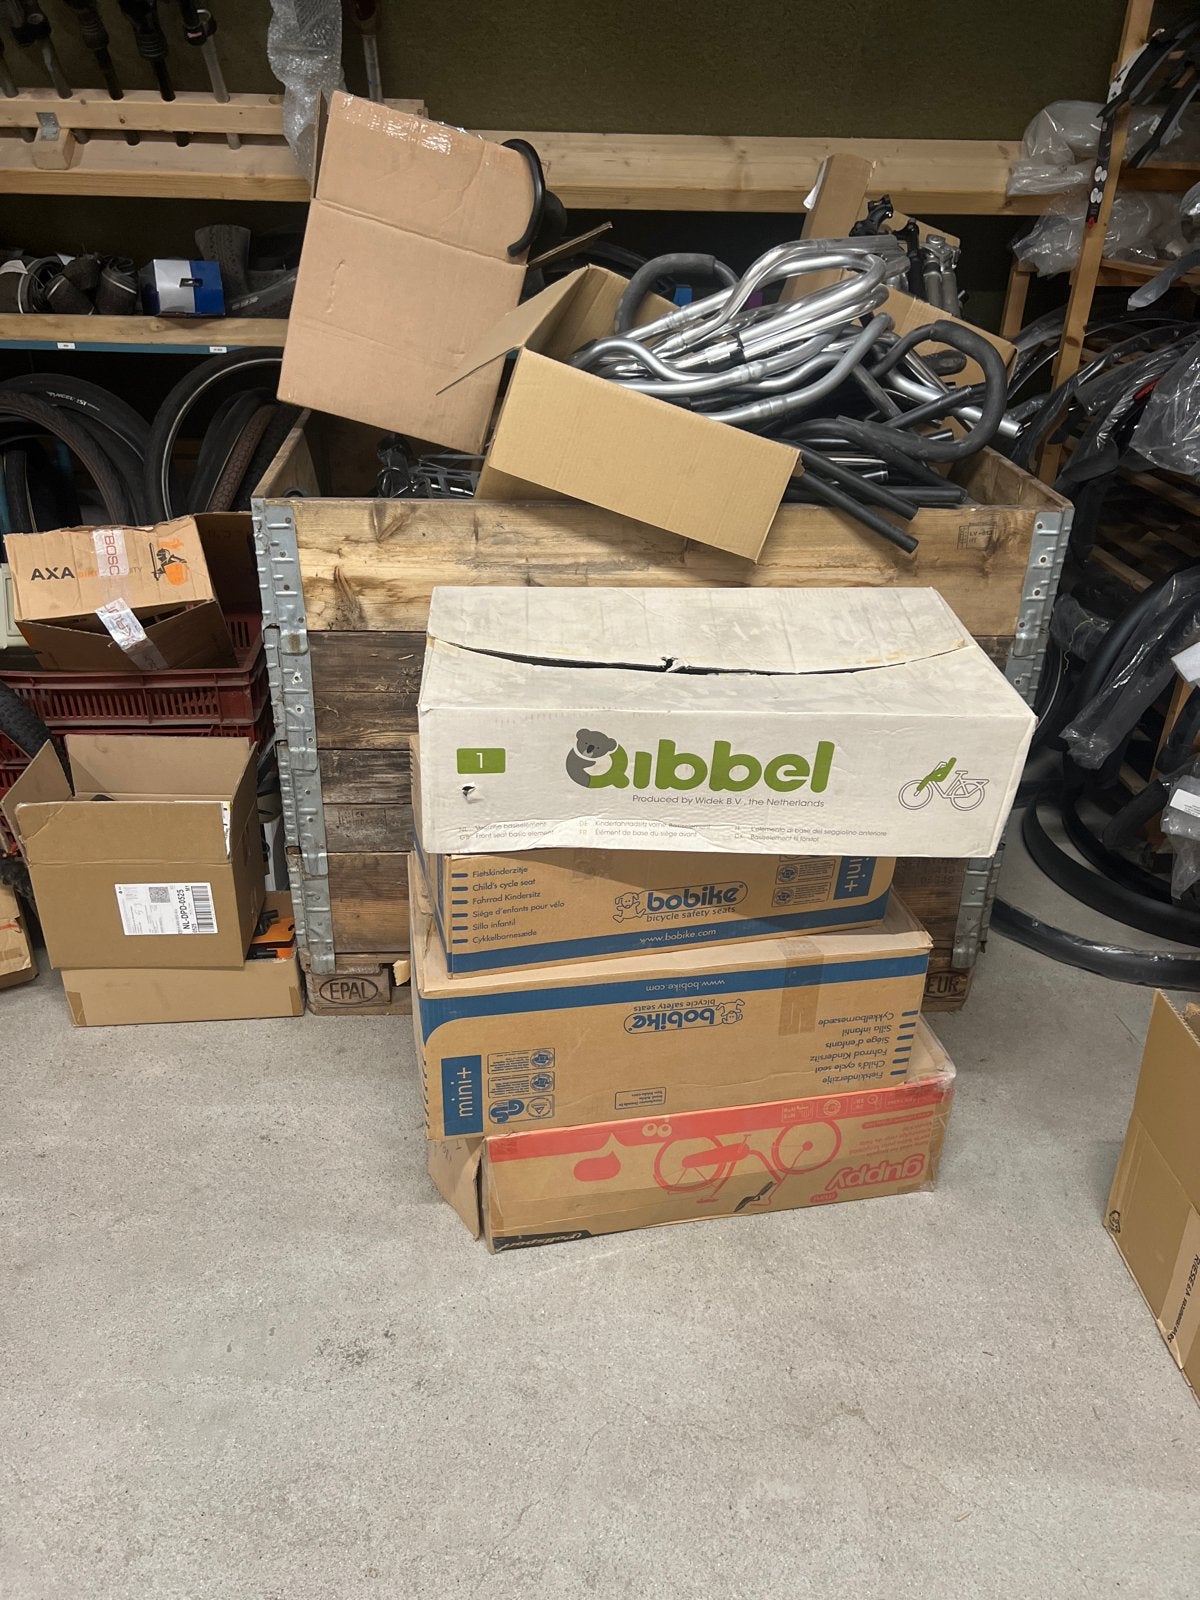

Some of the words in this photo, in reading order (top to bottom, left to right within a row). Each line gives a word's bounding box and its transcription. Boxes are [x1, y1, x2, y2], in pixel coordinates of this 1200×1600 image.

[31, 566, 76, 581] AXA
[476, 753, 484, 769] 1
[566, 737, 835, 793] Qibbel
[632, 794, 679, 804] Produced
[681, 796, 694, 806] by
[695, 796, 724, 806] Widek
[748, 798, 764, 807] the
[766, 798, 825, 808] Netherlands
[472, 867, 529, 879] Fietskinderzitje
[472, 882, 498, 892] Child's
[499, 879, 519, 890] cycle
[520, 878, 536, 887] seat
[472, 893, 503, 905] Fahrrad
[505, 891, 541, 901] Kindersitz
[647, 884, 740, 912] bobike
[177, 889, 190, 930] NL-DPD-0525
[530, 904, 549, 912] pour
[550, 900, 565, 908] vélo
[646, 912, 680, 923] bicycle
[682, 908, 710, 919] safety
[712, 905, 736, 915] seats
[472, 922, 489, 931] Silla
[491, 918, 516, 929] infantil
[639, 928, 717, 945] www.bobike.com
[330, 981, 371, 994] EPAL
[645, 979, 726, 993] www.bobike.com
[926, 975, 960, 994] EUR
[633, 1004, 656, 1012] seats
[657, 1002, 685, 1011] safety
[686, 998, 716, 1008] bicycle
[632, 1008, 715, 1031] bobike
[841, 1026, 872, 1037] infantil
[873, 1024, 892, 1035] Silla
[809, 1051, 852, 1063] Kindersitz
[853, 1048, 888, 1060] Fahrrad
[815, 1064, 832, 1073] seat
[834, 1061, 856, 1072] cycle
[857, 1059, 886, 1070] Child's
[821, 1071, 884, 1085] Fietskinderzitje
[450, 1067, 473, 1117] mini+
[825, 1153, 925, 1192] guppy
